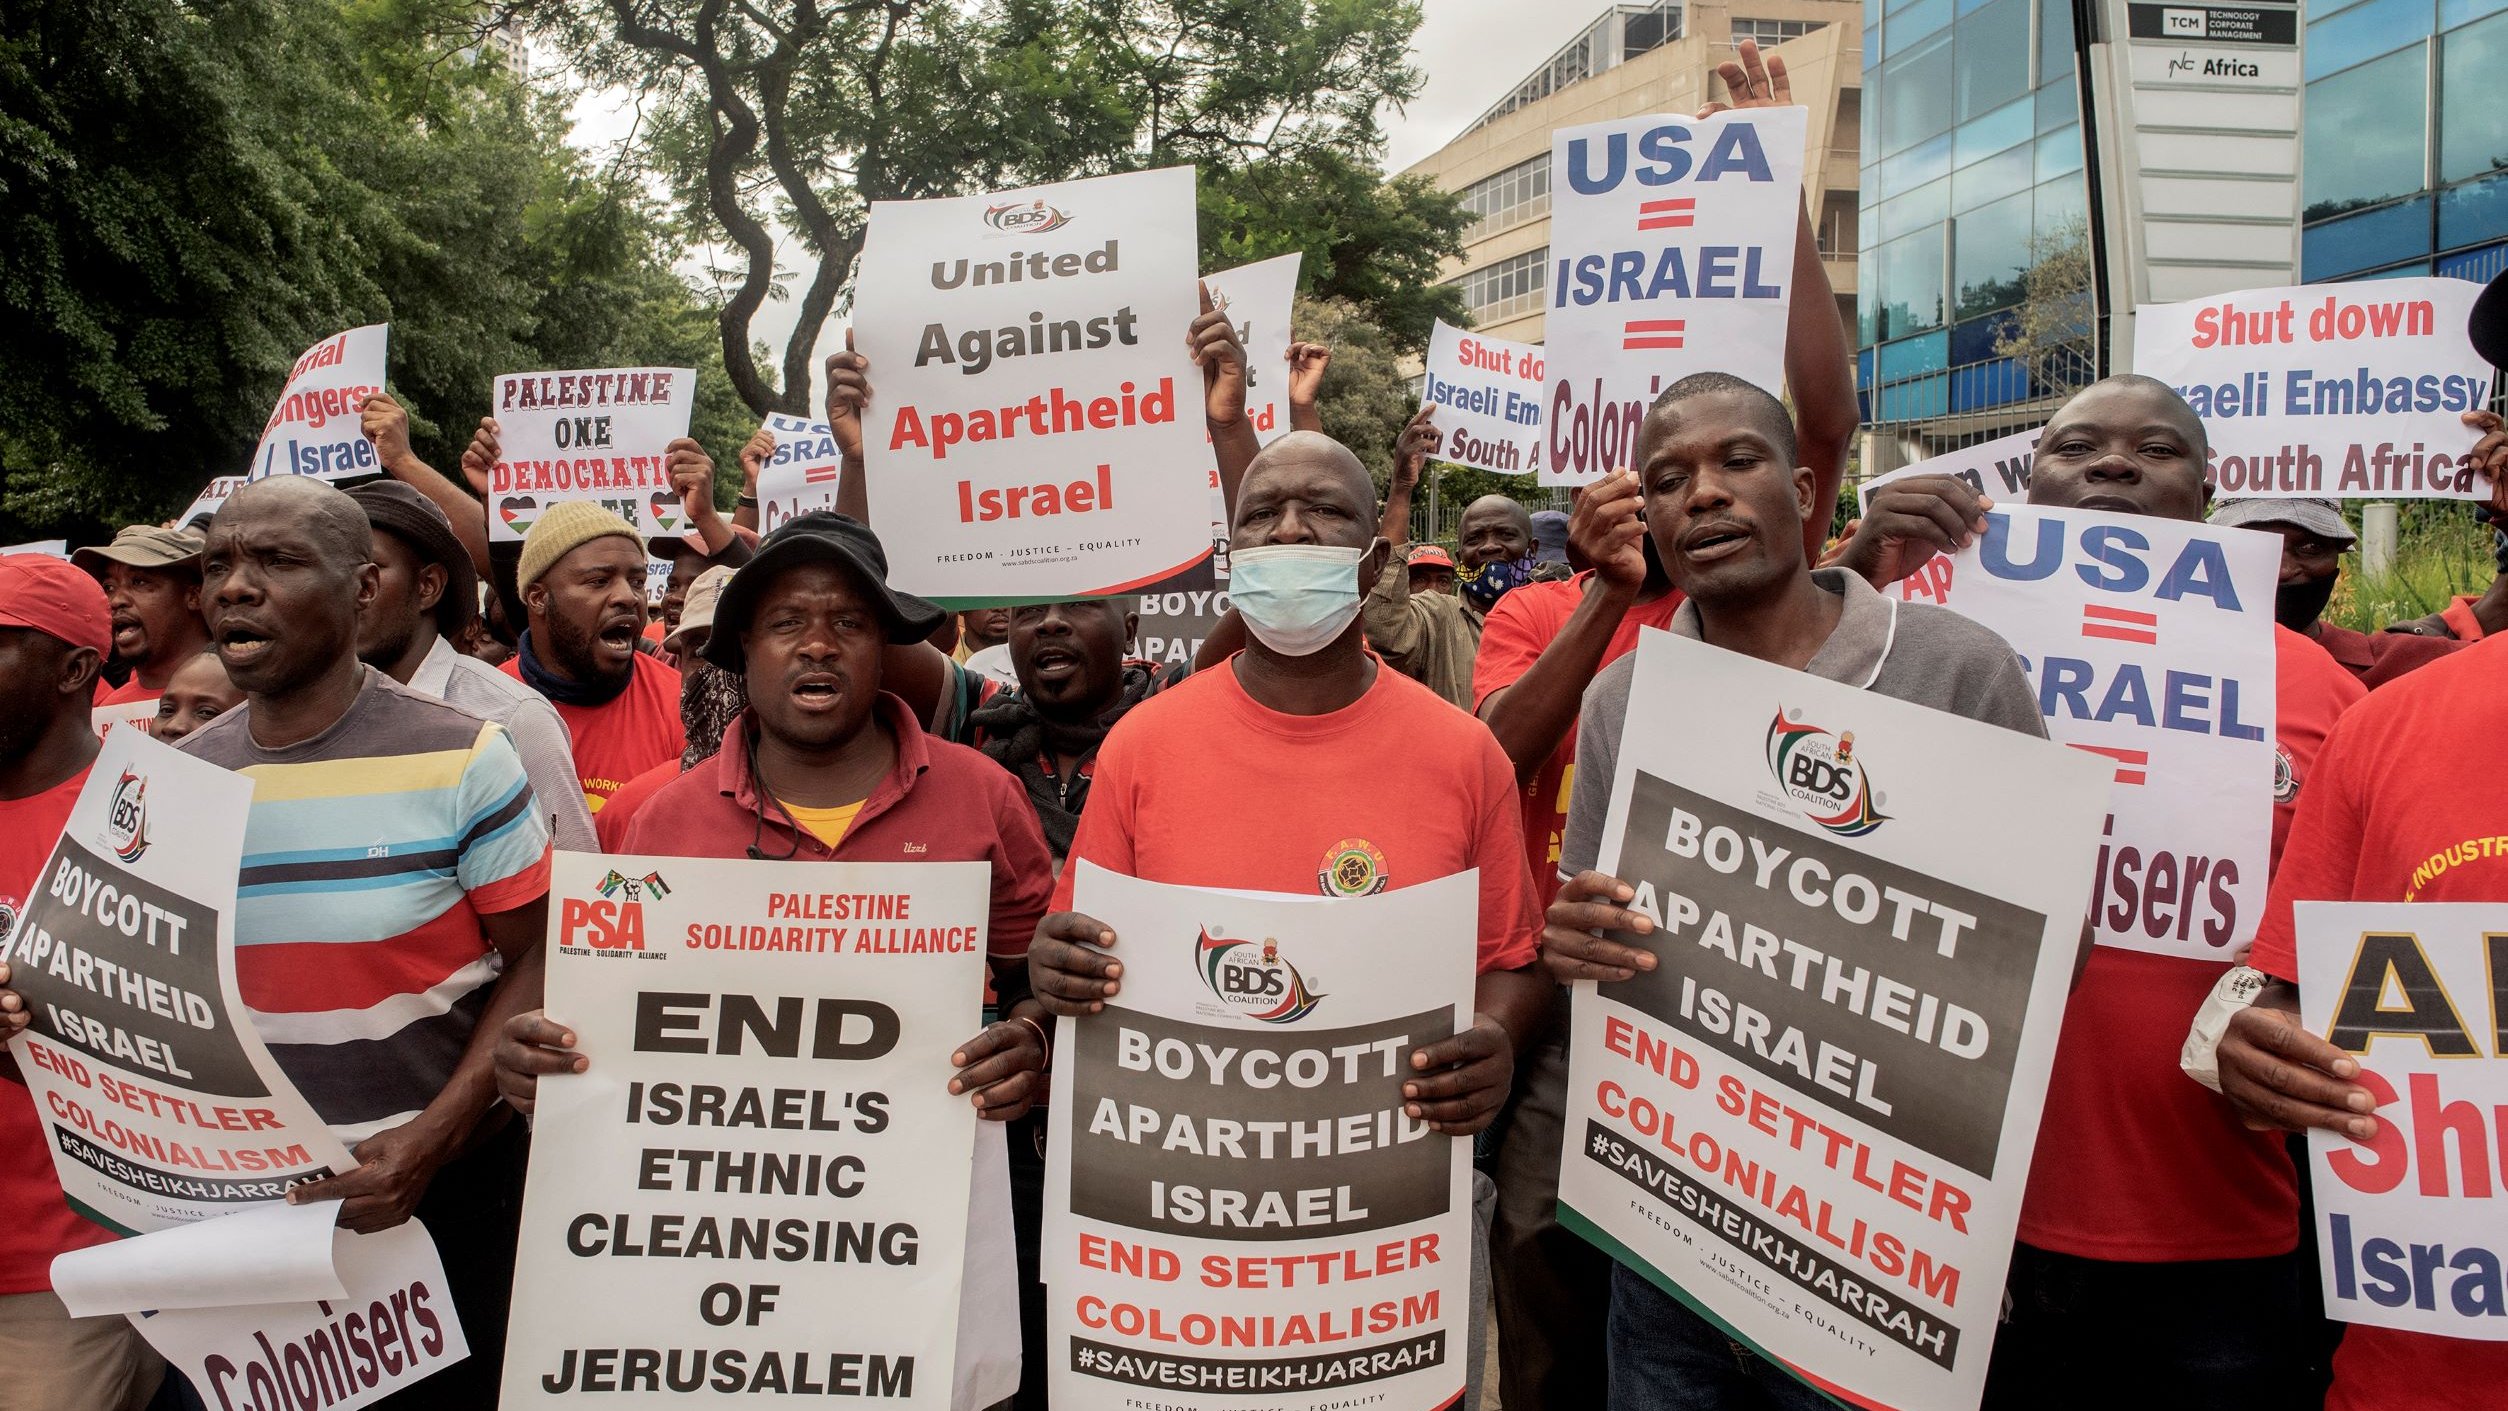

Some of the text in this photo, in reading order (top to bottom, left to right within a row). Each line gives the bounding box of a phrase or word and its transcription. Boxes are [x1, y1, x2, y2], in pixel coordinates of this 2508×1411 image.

[2171, 17, 2199, 28] TCM
[2209, 11, 2260, 20] TECHNOLOGY
[2209, 21, 2253, 29] CORPORATE
[2209, 30, 2262, 39] MANAGEMENT
[2203, 59, 2258, 77] Africa
[1567, 122, 1774, 195] USA
[1004, 210, 1046, 226] BDS
[930, 240, 1119, 290] United
[1555, 246, 1781, 308] ISRAEL
[914, 306, 1138, 375] Against
[2192, 297, 2433, 349] Shut down
[1458, 339, 1544, 382] Shut do
[503, 373, 672, 412] PALESTINE
[1426, 372, 1498, 416] Israeli
[2285, 367, 2487, 416] Embassy
[555, 415, 612, 451] ONE
[889, 377, 1175, 460] Apartheid
[1550, 375, 1660, 474] Colon
[1449, 428, 1519, 470] South
[2338, 443, 2474, 493] Africa
[958, 464, 1113, 523] Israel
[937, 552, 994, 563] FREEDOM
[1010, 545, 1060, 557] JUSTICE
[1079, 538, 1142, 551] EQUALITY
[1979, 512, 2243, 612] USA
[1140, 591, 1231, 617] BOYC
[1801, 745, 1831, 760] AFRICAN
[1808, 740, 1831, 751] SOUTH
[1790, 752, 1852, 800] BDS
[1791, 788, 1841, 811] COALITION
[113, 798, 140, 833] BDS
[50, 856, 187, 955] BOYCOTT
[768, 893, 911, 921] PALESTINE
[1665, 807, 1977, 959] BOYCOTT
[560, 898, 645, 950] PSA
[686, 924, 977, 954] SOLIDARITY ALLIANCE
[15, 922, 215, 1030] APARTHEID
[560, 946, 667, 961] PALESTINE SOLIDARITY ALLIANCE
[1228, 957, 1259, 966] AFRICAN
[1233, 951, 1257, 959] SOUTH
[1626, 880, 1990, 1060] APARTHEID
[1224, 964, 1284, 996] BDS
[1227, 995, 1278, 1005] COALITION
[47, 1003, 192, 1080] ISRAEL
[633, 991, 901, 1061] END
[1679, 977, 1893, 1117] ISRAEL
[1117, 1026, 1409, 1089] BOYCOTT
[25, 1040, 286, 1131] END SETTLER
[626, 1082, 890, 1134] ISRAEL'S
[47, 1090, 313, 1171] COLONIALISM
[1089, 1097, 1433, 1160] APARTHEID
[1605, 1015, 1972, 1236] END SETTLER
[638, 1148, 866, 1199] ETHNIC
[1597, 1080, 1961, 1308] COLONIALISM
[1151, 1182, 1368, 1228] ISRAEL
[566, 1213, 920, 1266] CLEANSING
[1079, 1232, 1441, 1289] END SETTLER
[1592, 1133, 1946, 1356] #SAVESHEIKHJARRAH
[2329, 1213, 2508, 1317] Isra
[699, 1282, 781, 1327] OF
[1631, 1201, 1692, 1246] FREEDOM
[1711, 1253, 1770, 1295] JUSTICE
[1795, 1304, 1876, 1357] EQUALITY
[1700, 1258, 1790, 1320] www.sabdscoalition.org.za
[1076, 1290, 1440, 1348] COLONIALISM
[204, 1281, 444, 1411] Colonisers
[1078, 1339, 1436, 1389] #SAVESHEIKHJARRAH
[541, 1348, 915, 1399] JERUSALEM
